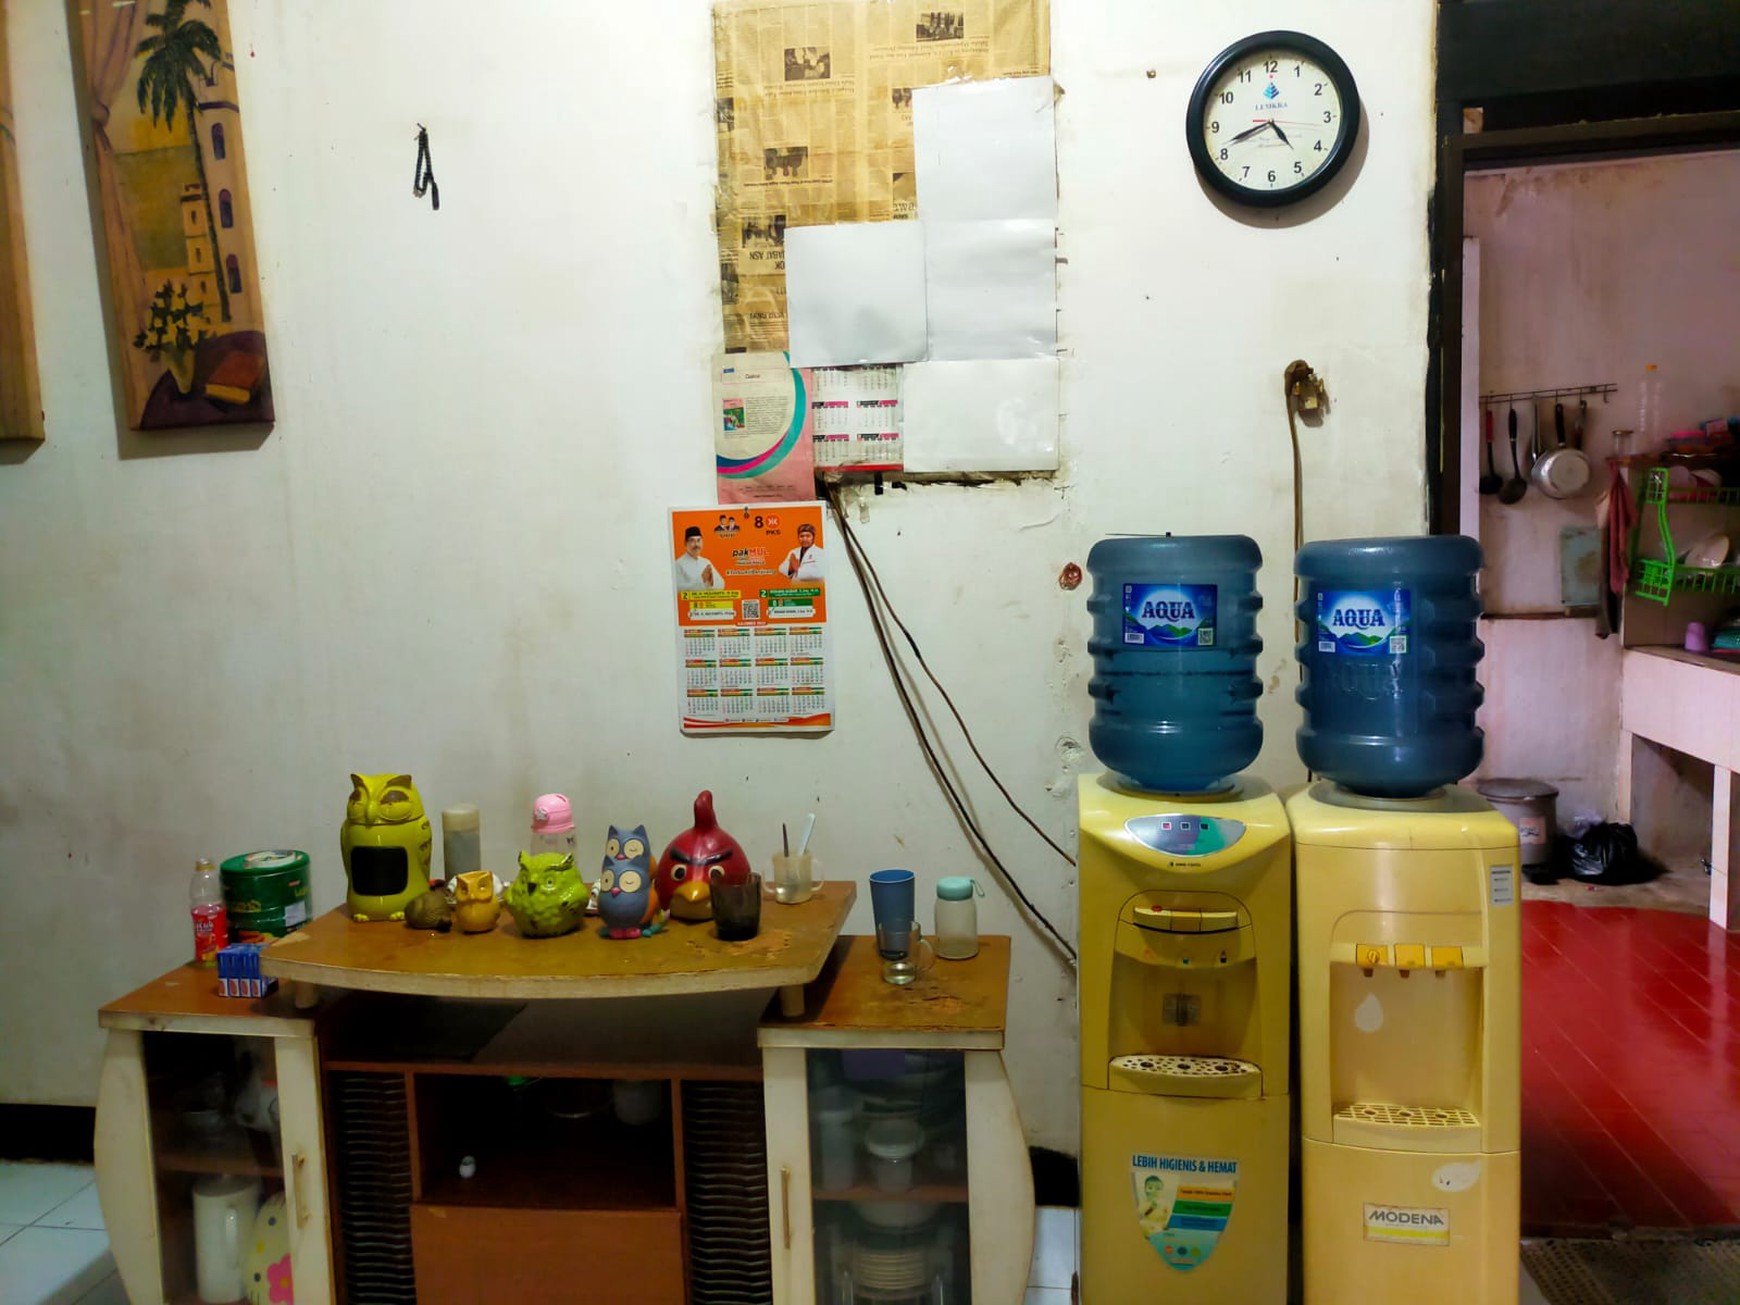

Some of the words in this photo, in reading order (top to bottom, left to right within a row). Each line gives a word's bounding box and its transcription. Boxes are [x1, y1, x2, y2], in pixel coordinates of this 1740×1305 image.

[1264, 60, 1278, 73] 12
[1293, 65, 1301, 78] 1
[1237, 70, 1252, 84] 11
[1314, 83, 1323, 96] 2
[1219, 91, 1234, 105] 10
[1323, 111, 1332, 123] 3
[1211, 121, 1220, 133] 9
[1313, 140, 1322, 152] 4
[1220, 148, 1229, 161] 8
[1242, 166, 1250, 179] 7
[1293, 161, 1302, 174] 5
[1267, 170, 1276, 183] 6
[754, 515, 764, 529] 8
[682, 592, 688, 600] 2
[761, 589, 767, 598] 2
[1141, 601, 1195, 622] AQUA
[1332, 608, 1386, 630] AQUA
[1132, 1155, 1158, 1169] LEBIH
[1159, 1157, 1198, 1172] HIGIENIS
[1199, 1161, 1206, 1173] &
[1207, 1161, 1238, 1174] HEMAT
[1368, 1210, 1445, 1226] MODENA
